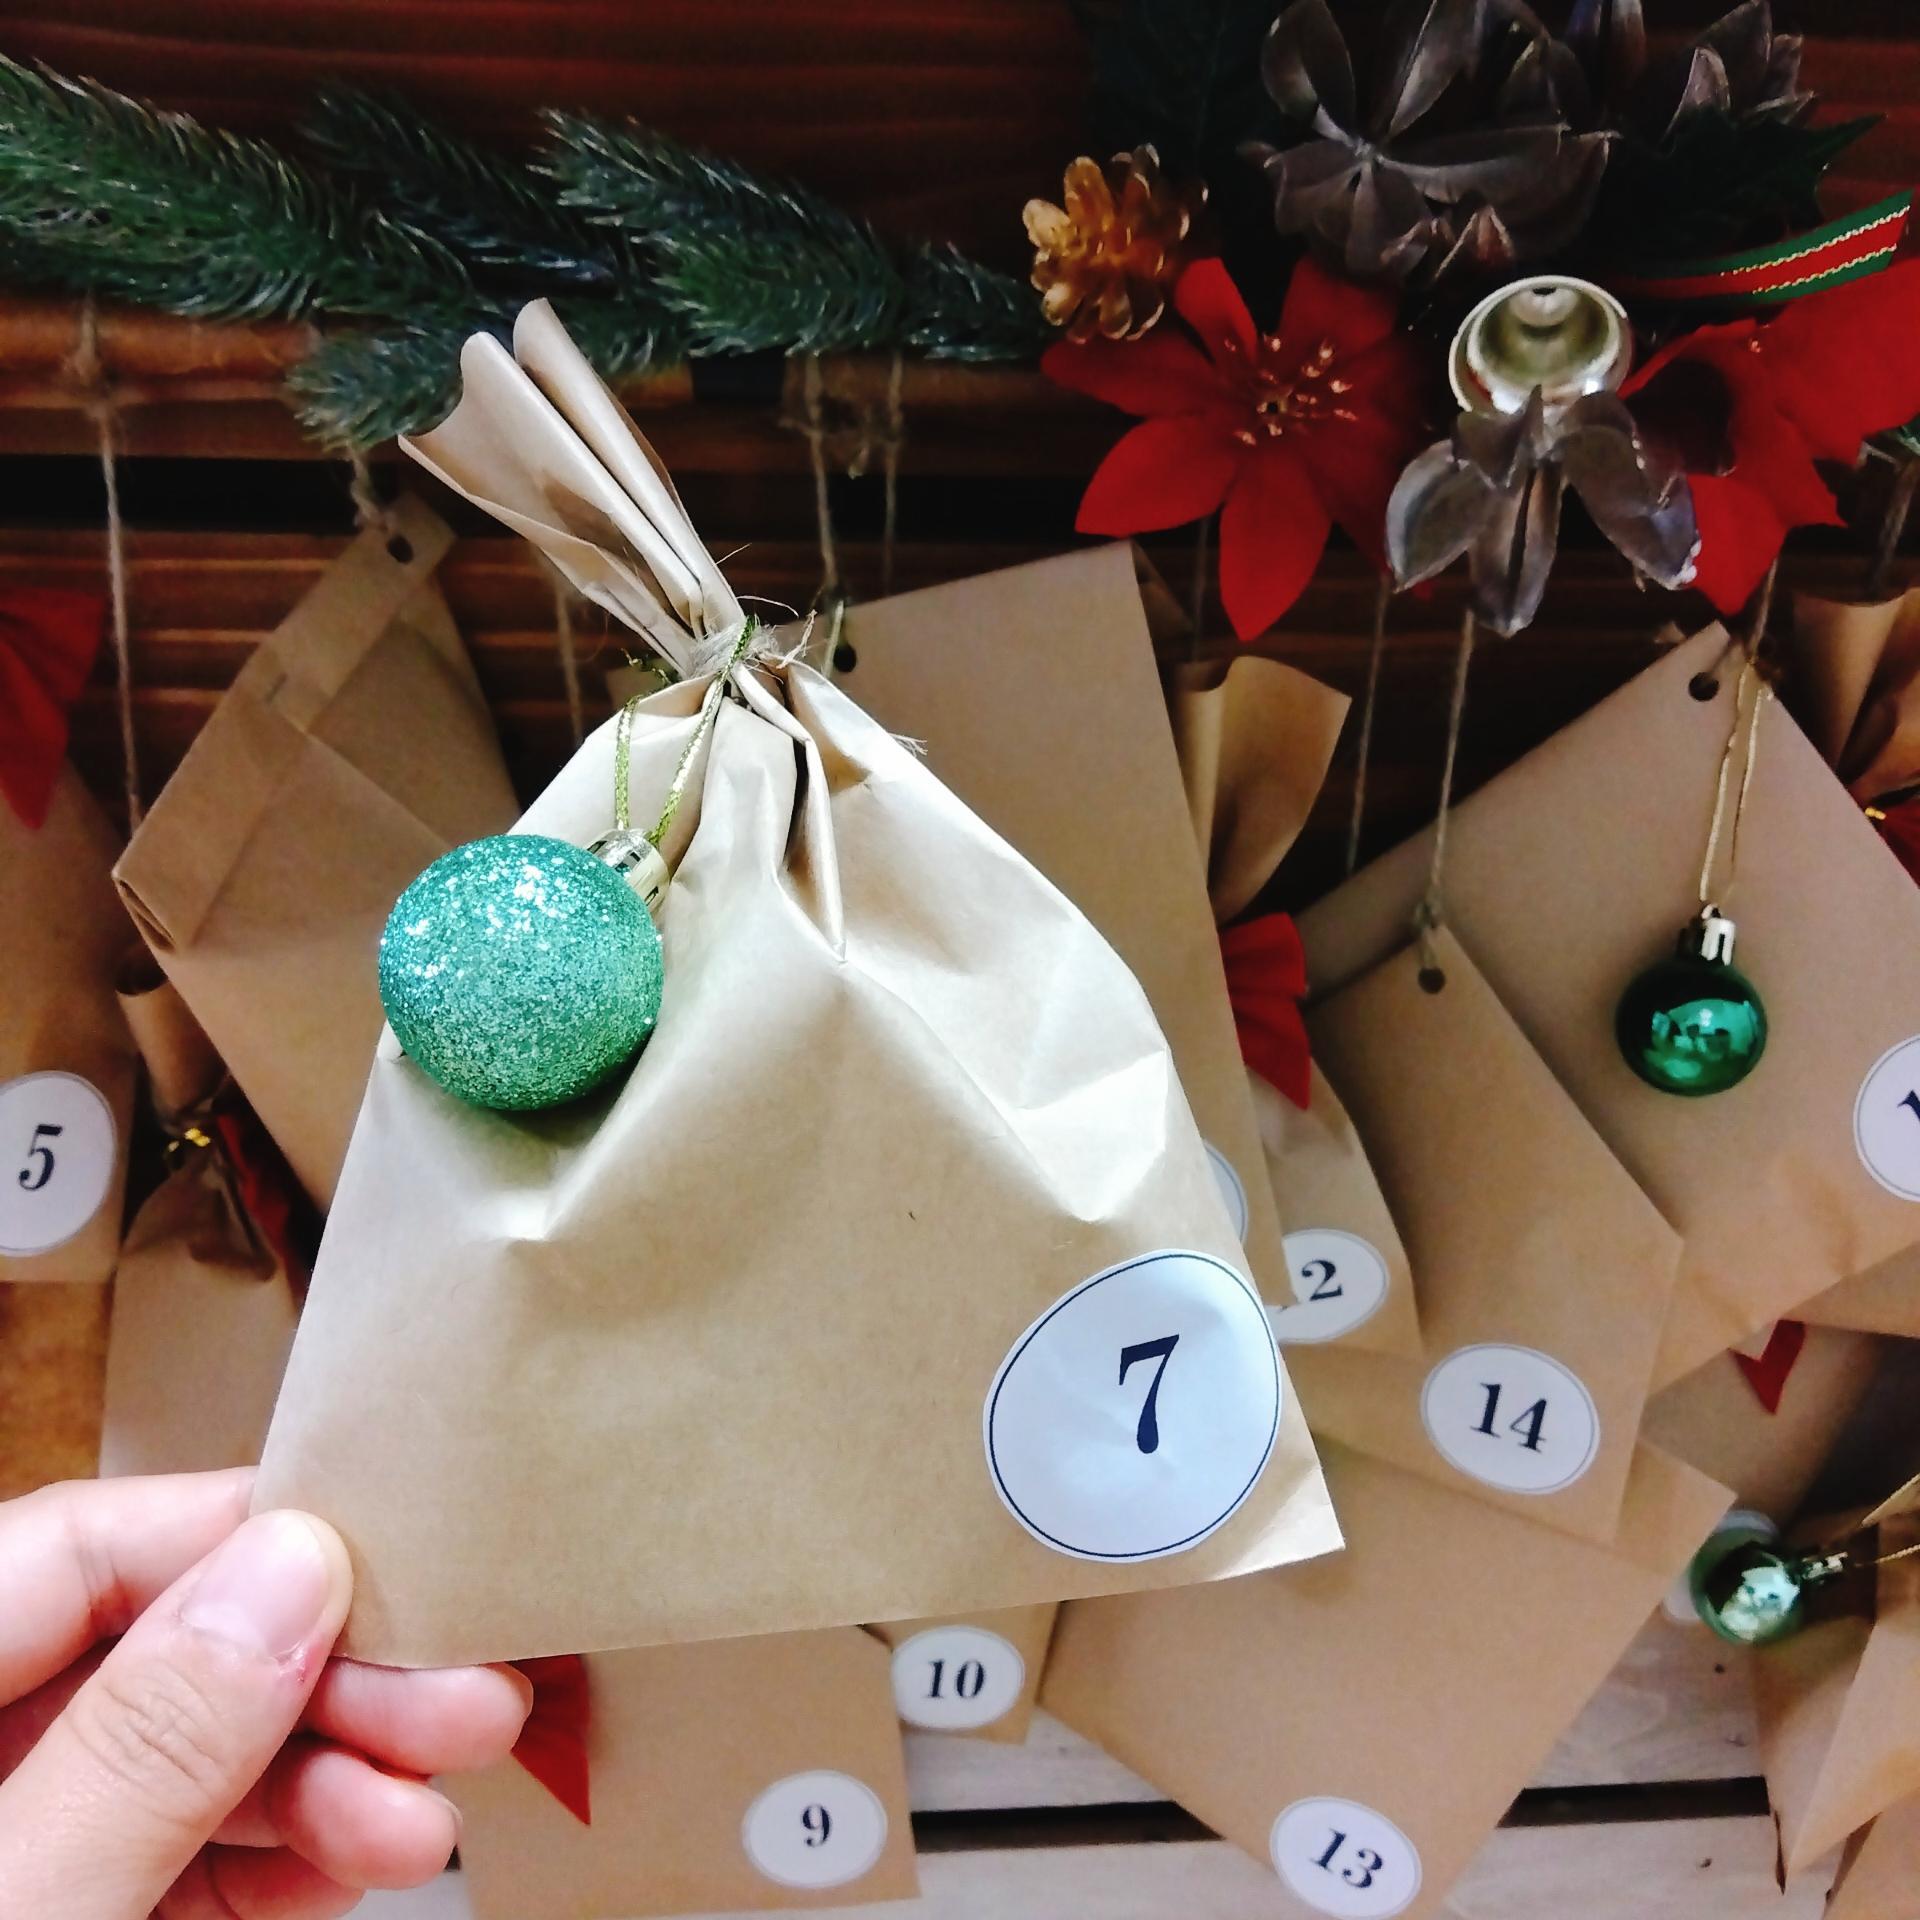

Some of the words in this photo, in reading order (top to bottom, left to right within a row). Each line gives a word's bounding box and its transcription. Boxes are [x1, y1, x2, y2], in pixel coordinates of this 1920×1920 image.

[18, 1123, 64, 1191] 5
[1119, 1333, 1180, 1454] 7
[1469, 1382, 1548, 1454] 14
[926, 1659, 985, 1699] 10
[801, 1804, 832, 1848] 9
[1308, 1827, 1383, 1888] 13
